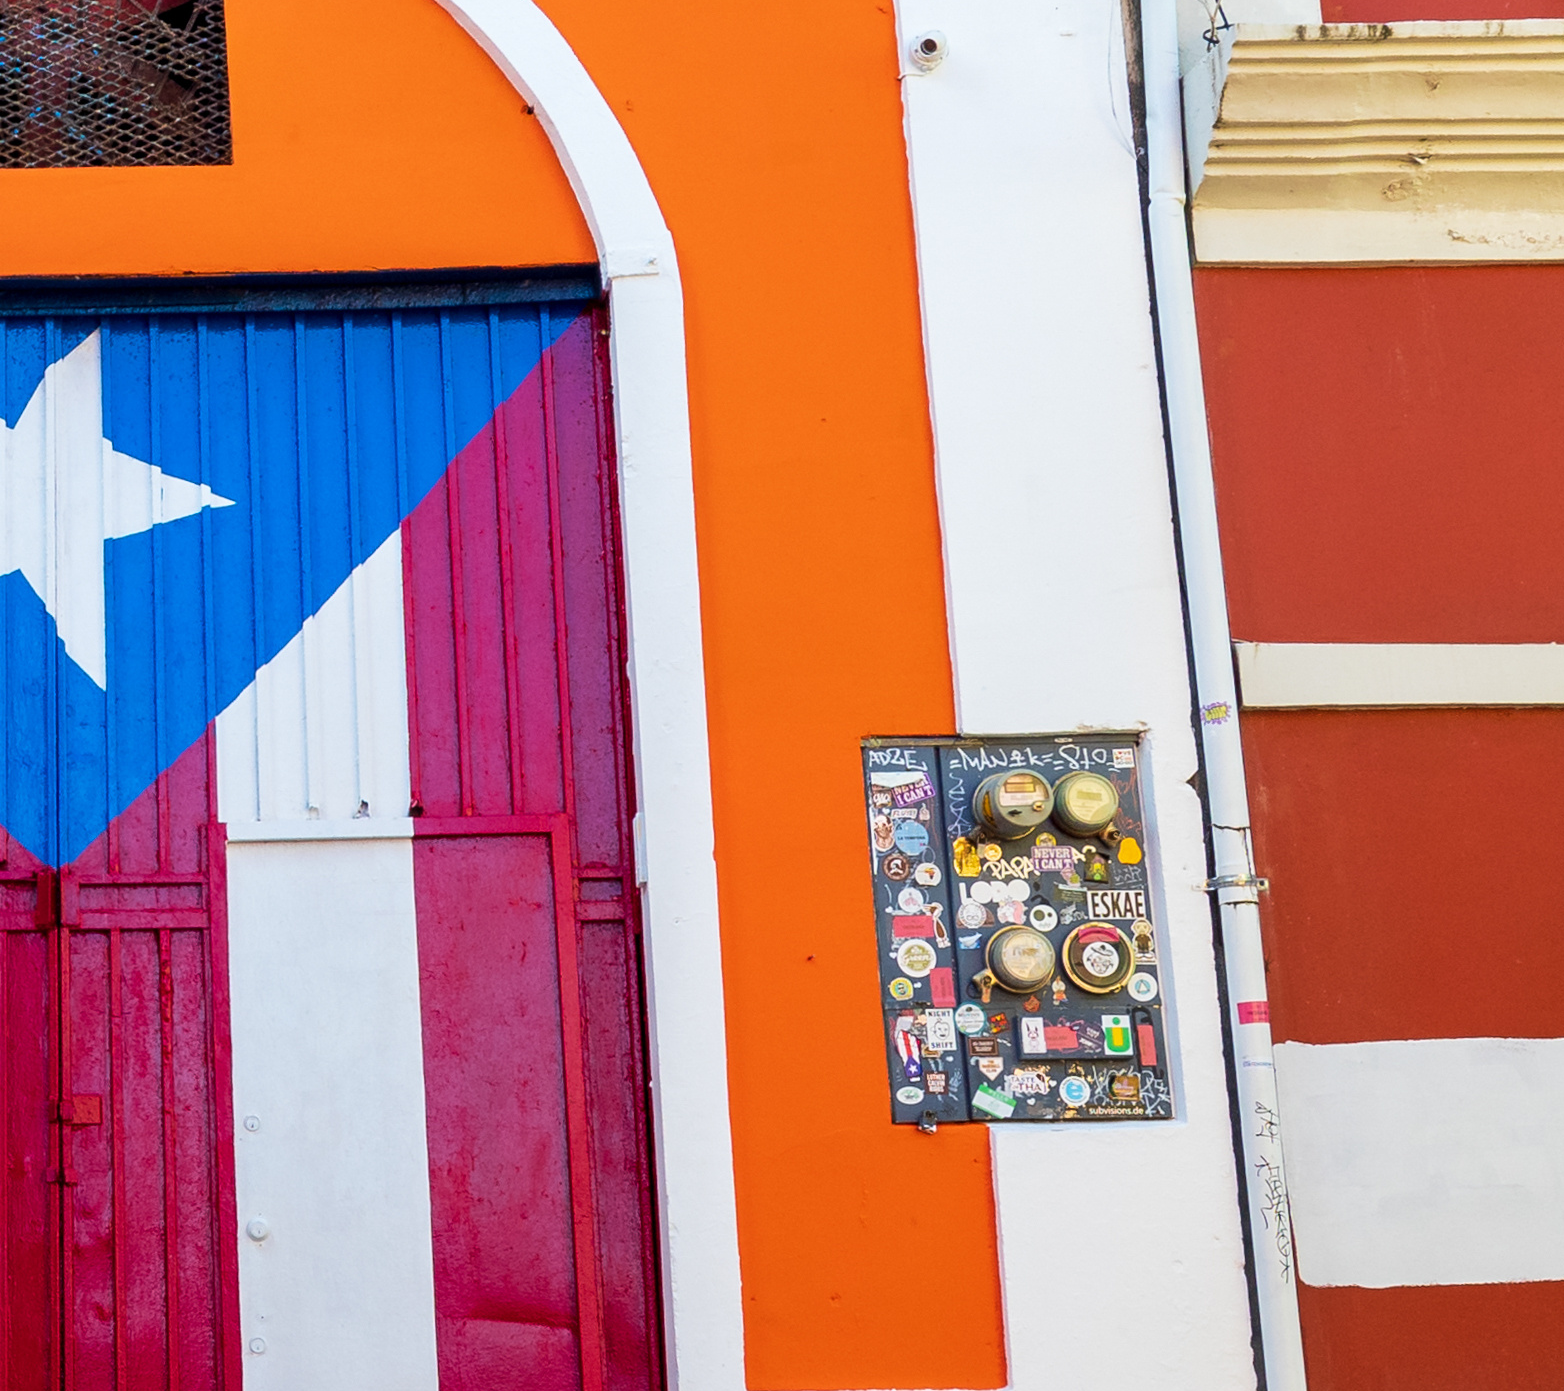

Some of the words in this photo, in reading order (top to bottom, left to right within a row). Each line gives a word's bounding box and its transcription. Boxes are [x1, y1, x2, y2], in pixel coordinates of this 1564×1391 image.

[1034, 848, 1071, 858] NEVER
[1090, 892, 1145, 918] ESKAE
[1088, 1107, 1145, 1115] subvisions.de
